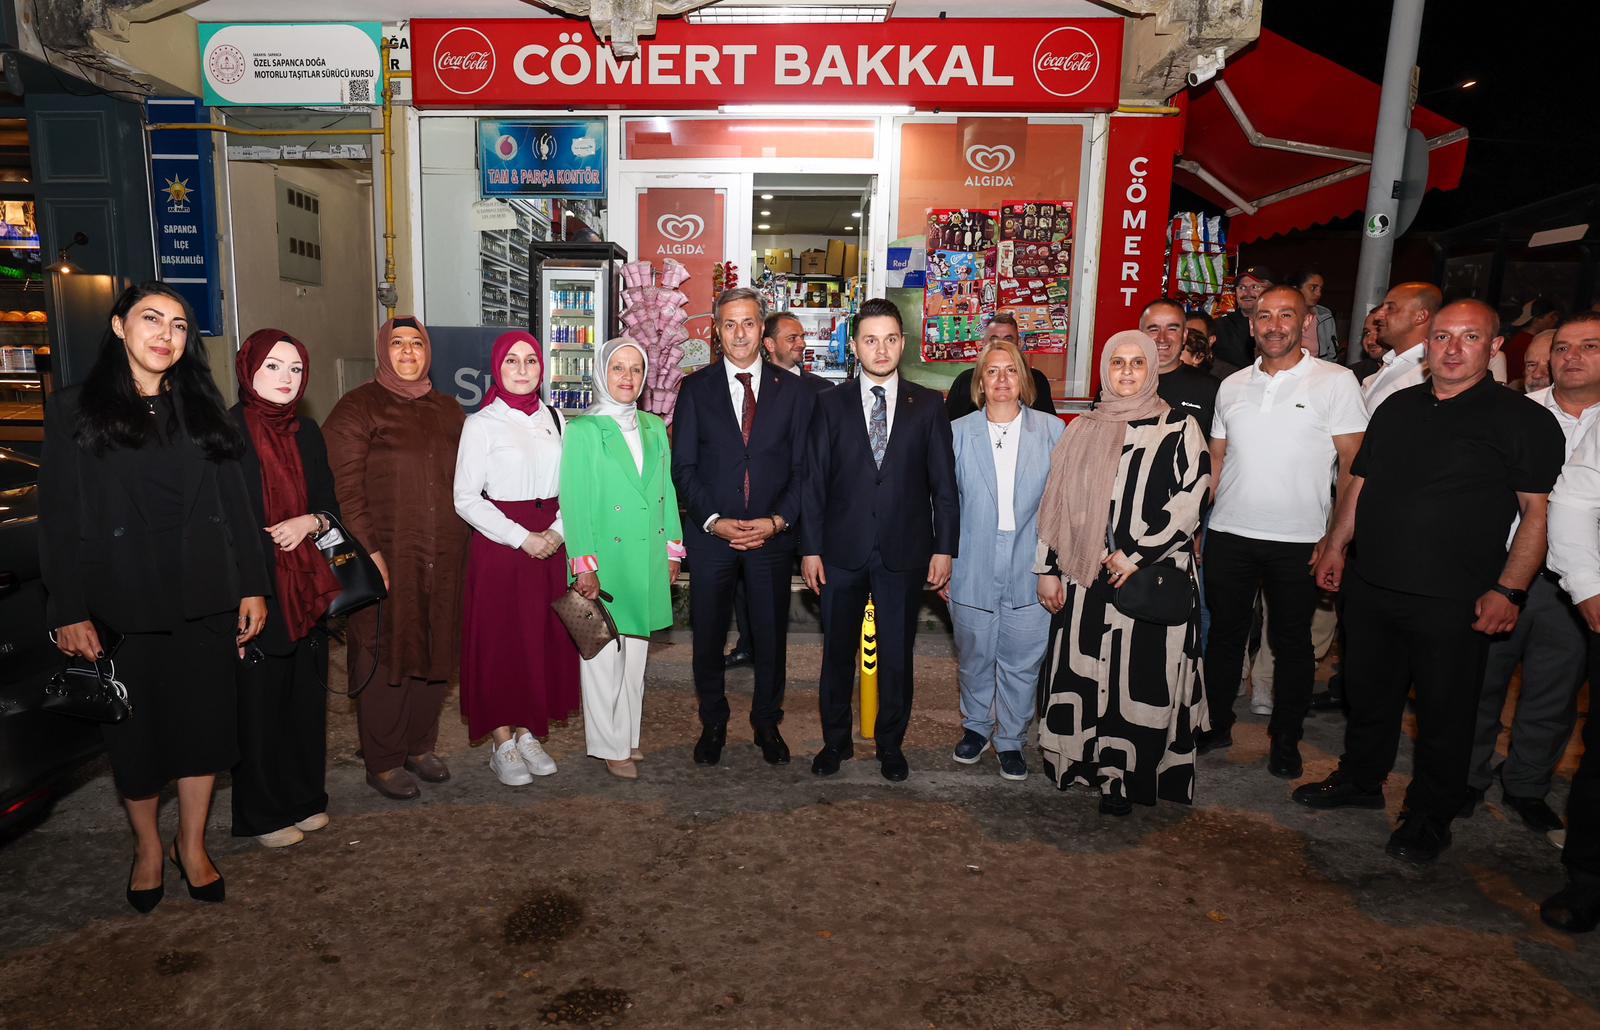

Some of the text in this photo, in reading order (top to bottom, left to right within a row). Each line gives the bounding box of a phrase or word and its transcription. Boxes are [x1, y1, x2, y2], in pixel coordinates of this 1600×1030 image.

[253, 57, 326, 67] ÖZEL SAPANCA DOĞA
[513, 32, 1014, 86] CÖMERT BAKKAL
[254, 68, 374, 80] MOTORLU TAŞITLAR SÜRÜCÜ KURSU
[488, 166, 600, 188] TAM & PARÇA KONTÖR
[163, 224, 198, 234] SAPANCA
[1120, 156, 1149, 307] CÖMERT
[174, 239, 189, 251] İLÇE
[161, 254, 204, 266] BAŞKANLIĞI
[893, 259, 907, 267] Red
